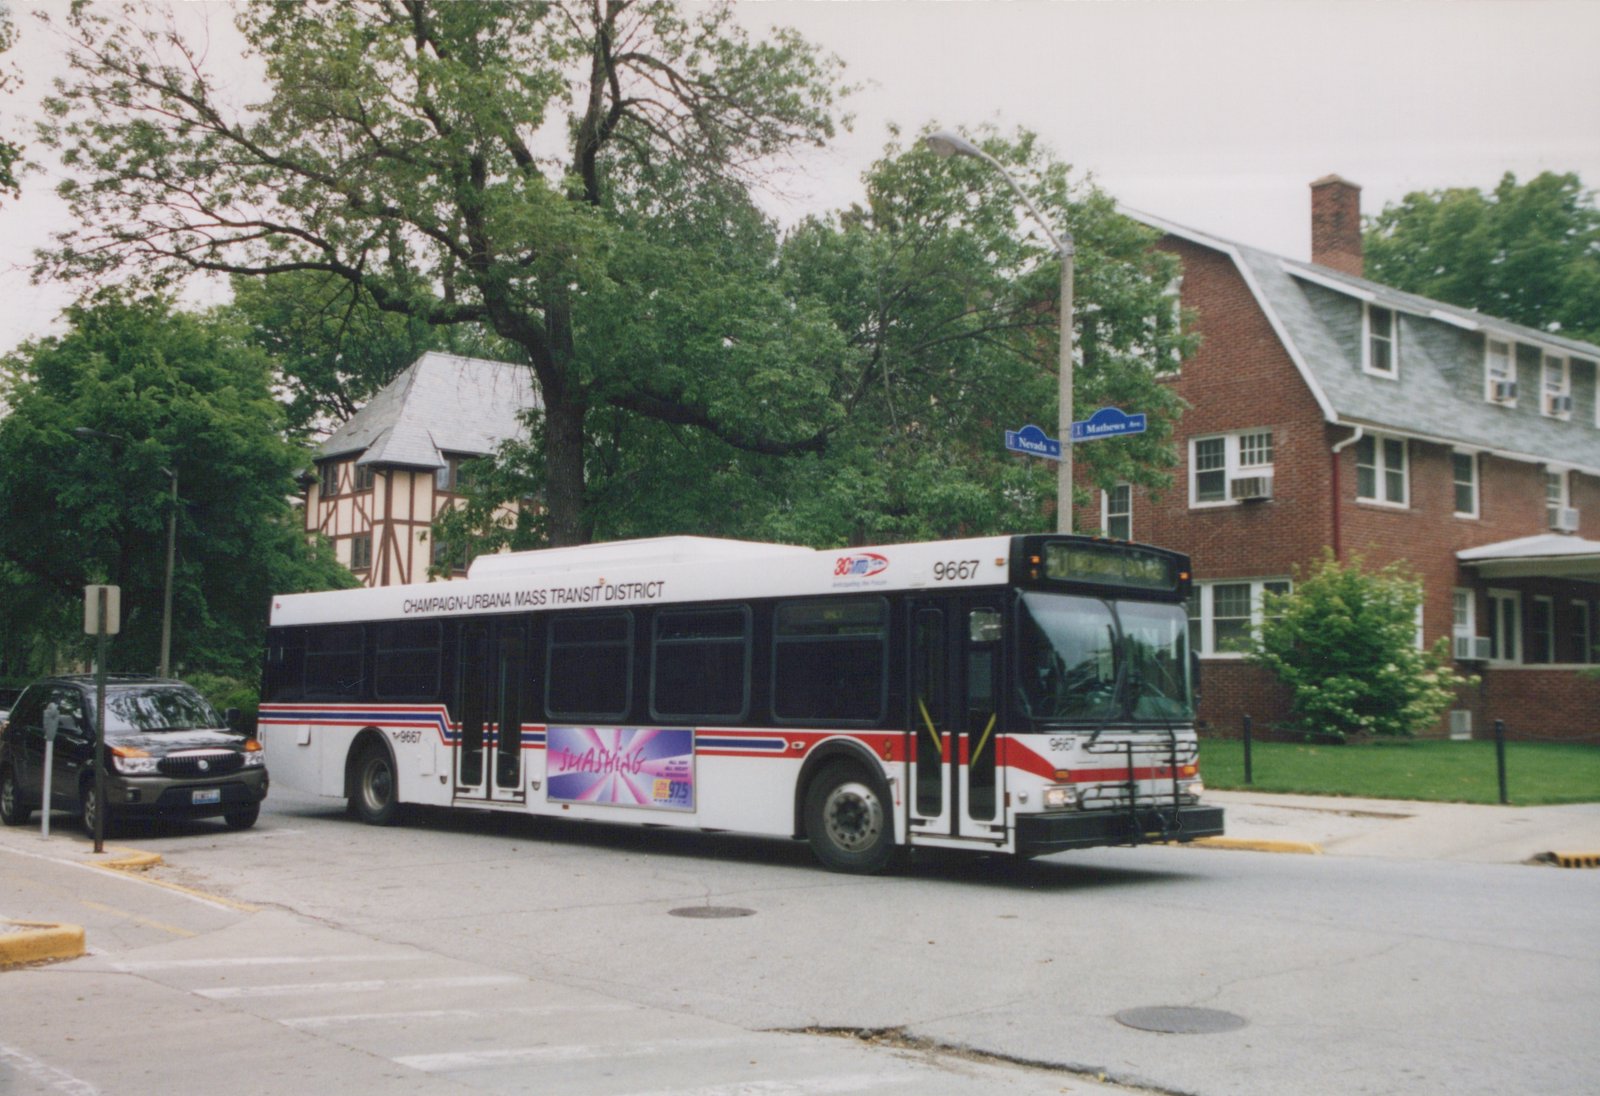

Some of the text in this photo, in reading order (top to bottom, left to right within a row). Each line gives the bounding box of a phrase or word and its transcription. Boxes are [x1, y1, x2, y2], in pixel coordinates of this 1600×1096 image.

[1019, 437, 1047, 452] Nevada
[933, 560, 980, 581] 9667
[403, 581, 665, 614] CHAMPAIGN-URBANA MASS TRANSIT DISTRICT
[400, 730, 421, 743] 9667
[1050, 738, 1076, 751] 9667
